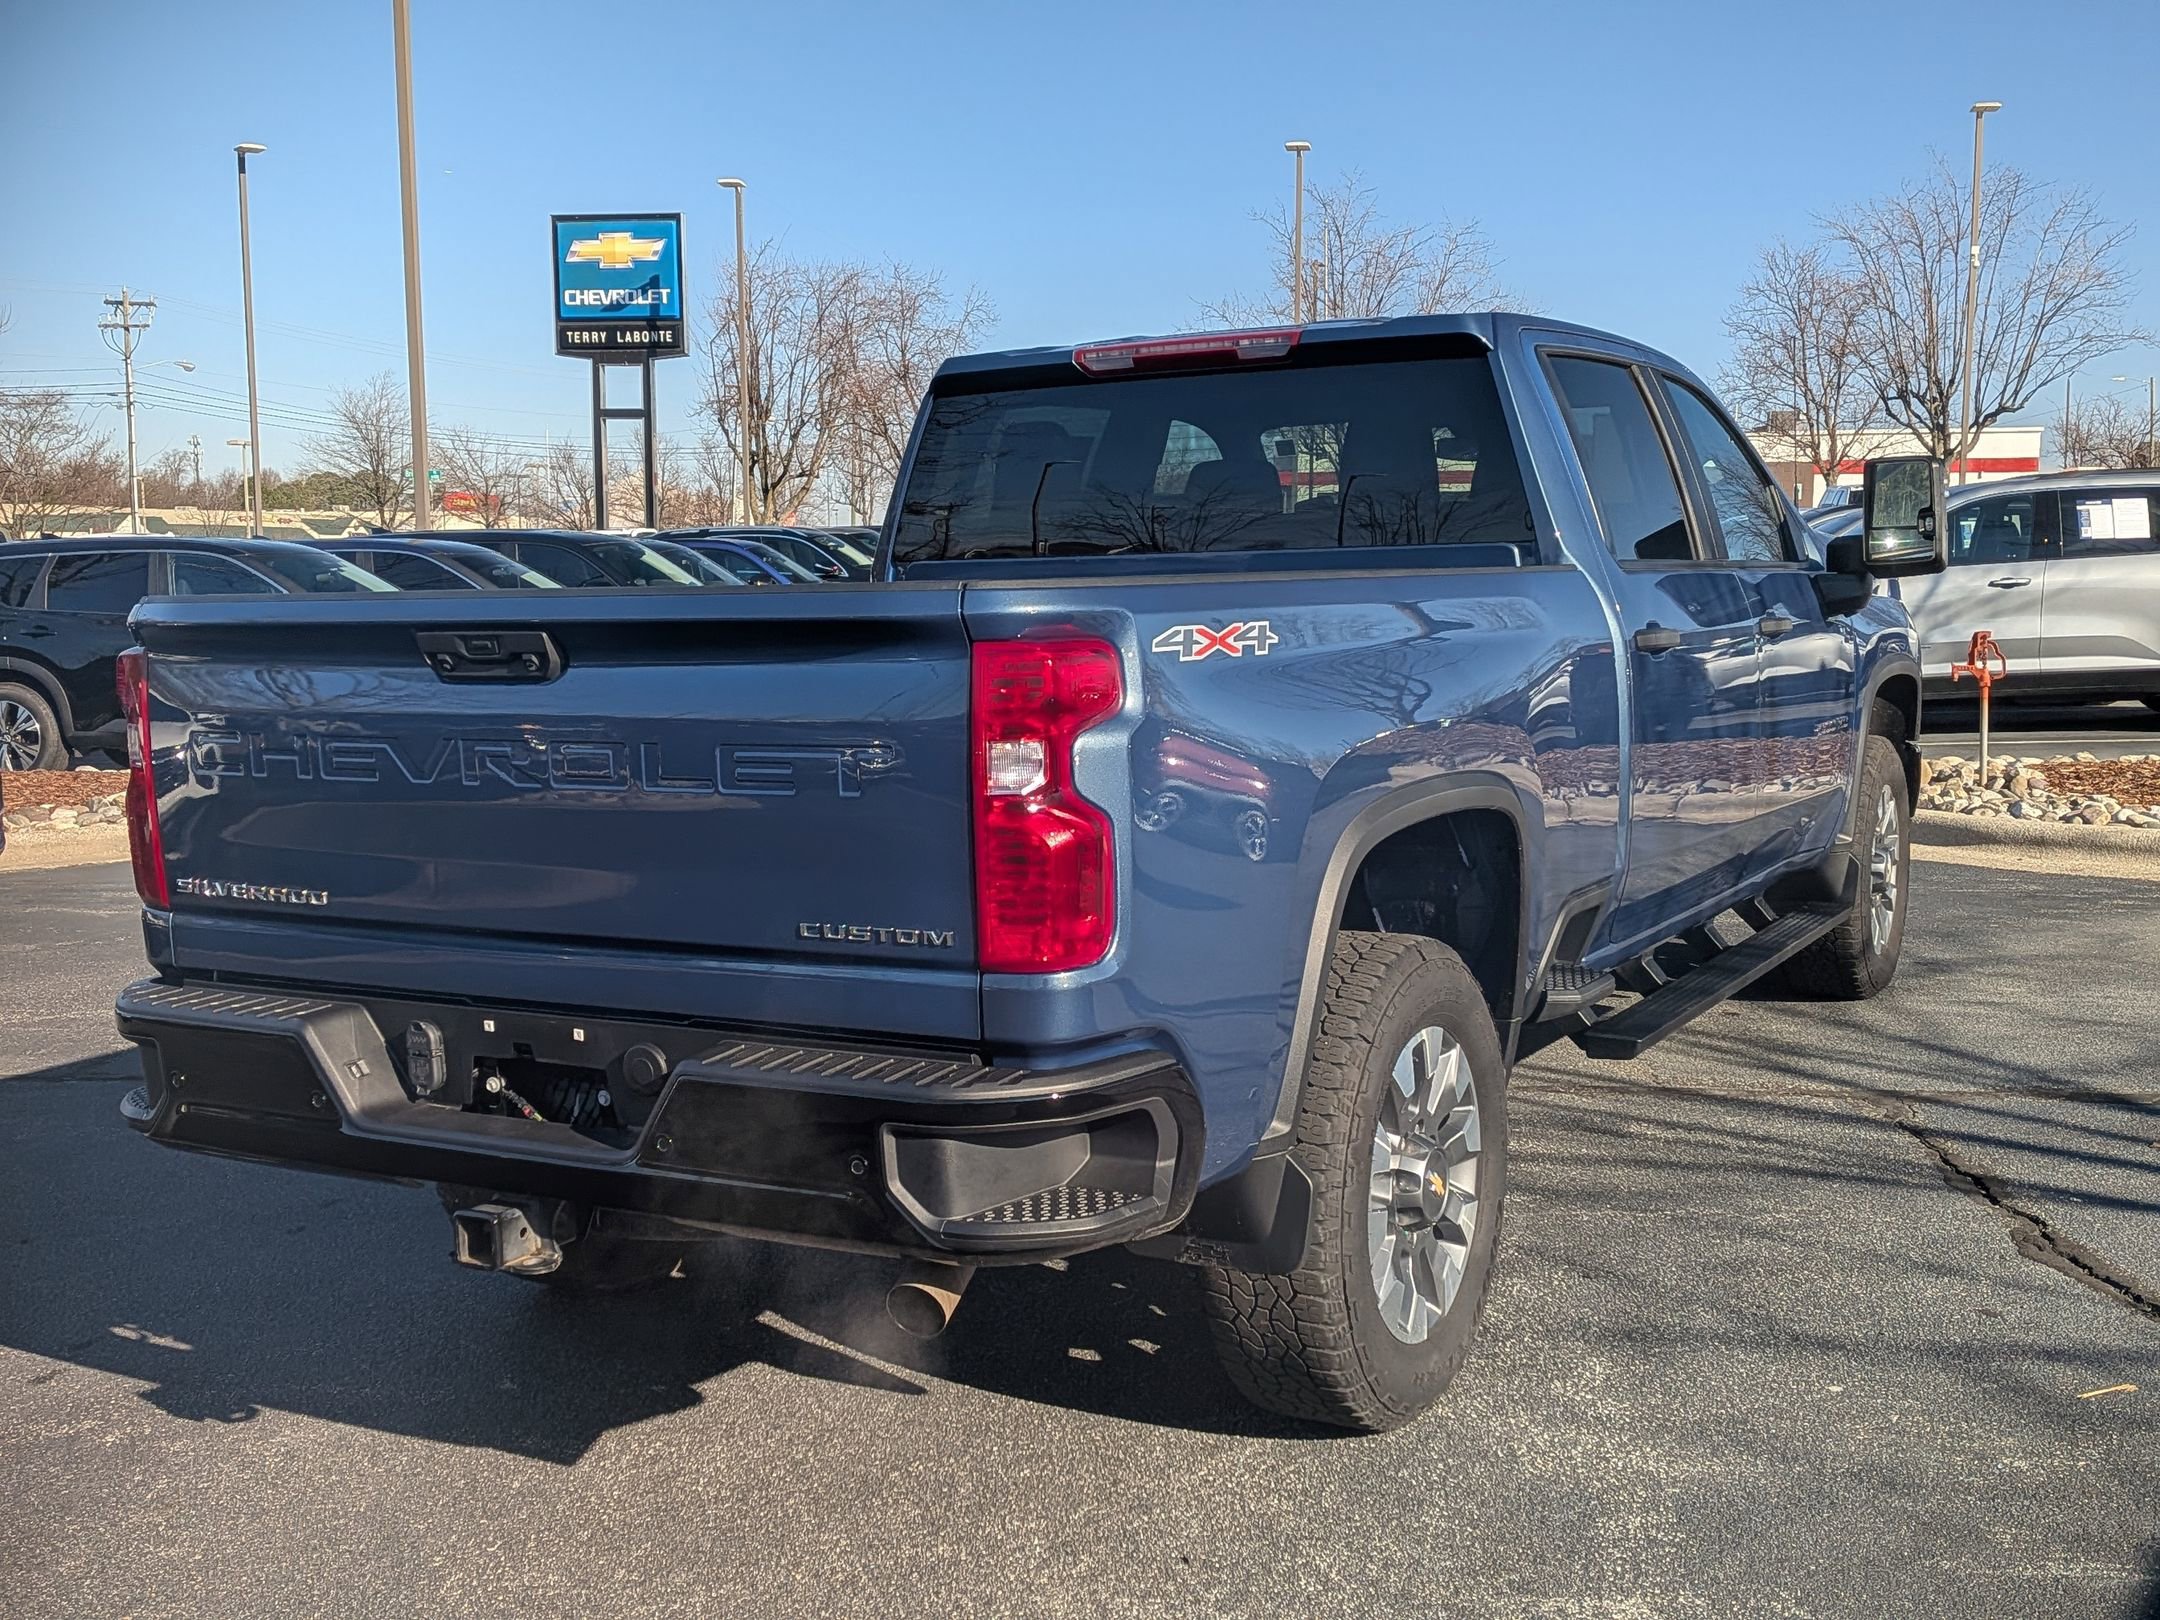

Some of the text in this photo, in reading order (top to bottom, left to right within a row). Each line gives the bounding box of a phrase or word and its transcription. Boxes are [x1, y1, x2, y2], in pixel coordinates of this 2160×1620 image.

[564, 288, 671, 305] CHEVROLET
[566, 330, 673, 343] TERRY LABONTE
[189, 731, 895, 797] CHEVROLET
[176, 877, 328, 905] SILVERADO
[799, 922, 954, 946] CUSTOM
